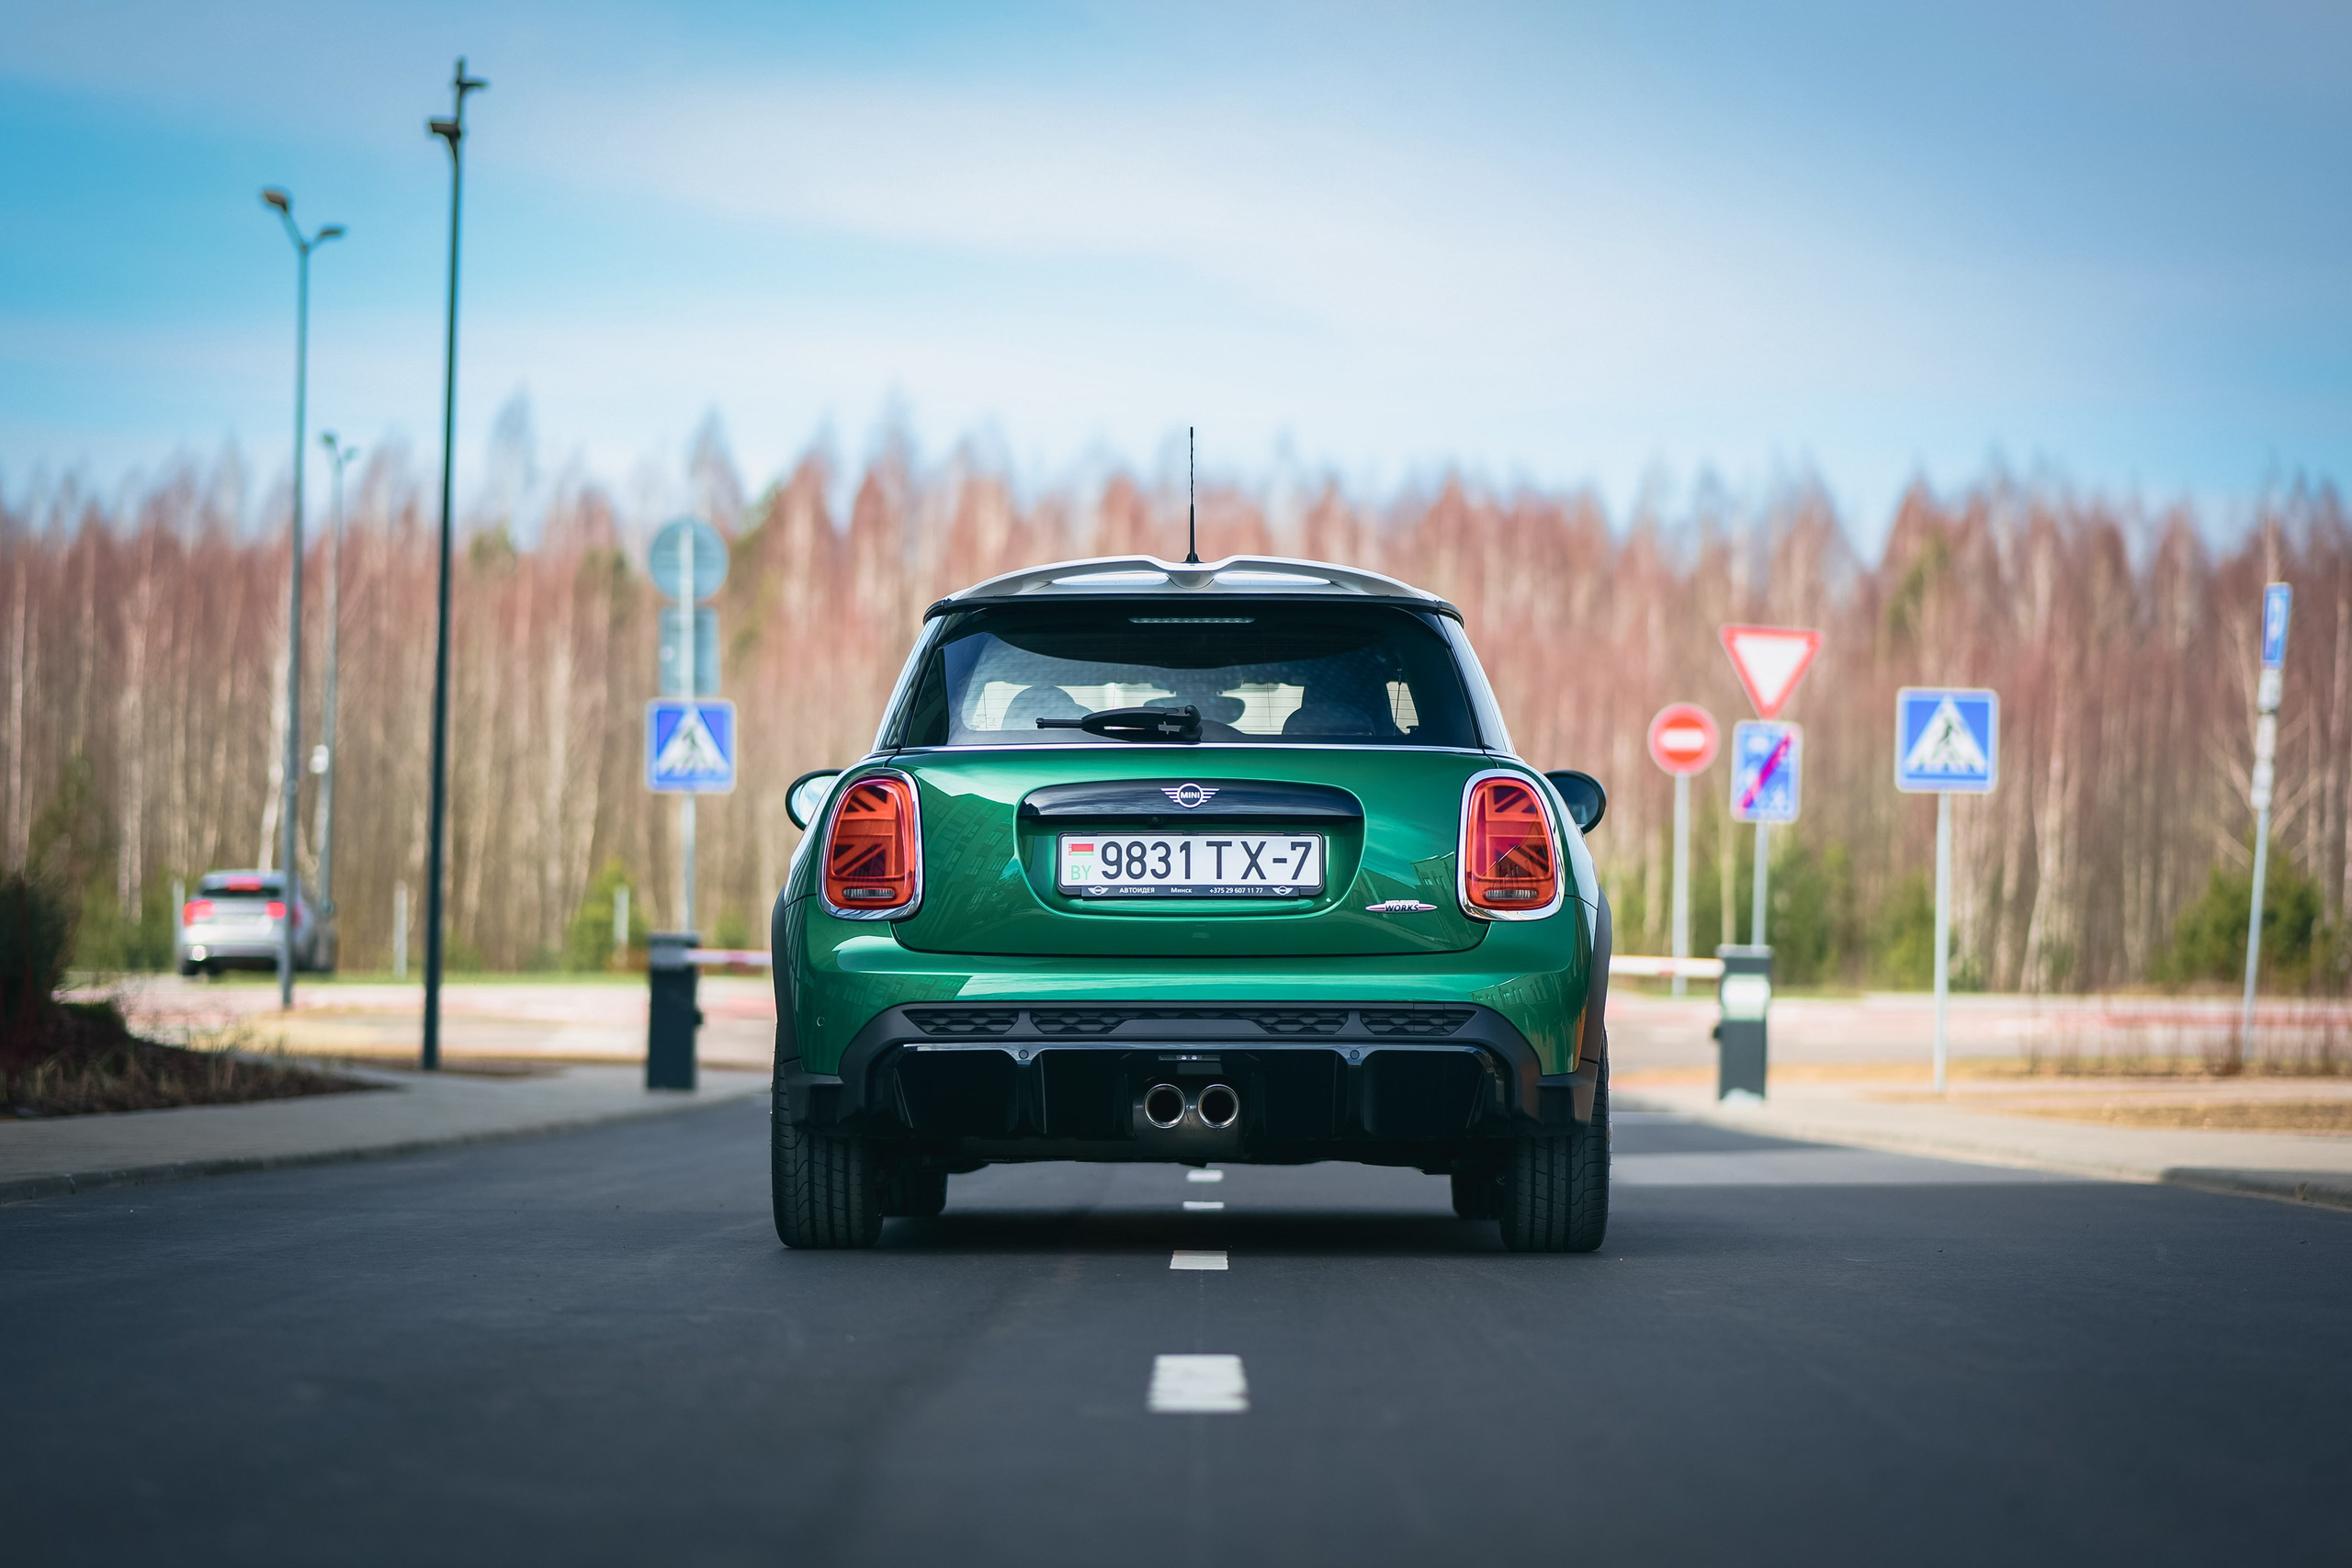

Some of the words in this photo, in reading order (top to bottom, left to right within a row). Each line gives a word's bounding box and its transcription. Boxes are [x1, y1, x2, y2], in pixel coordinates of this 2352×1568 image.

[1071, 864, 1091, 880] BY
[1101, 840, 1192, 880] 9831
[1205, 840, 1312, 880] TX-7
